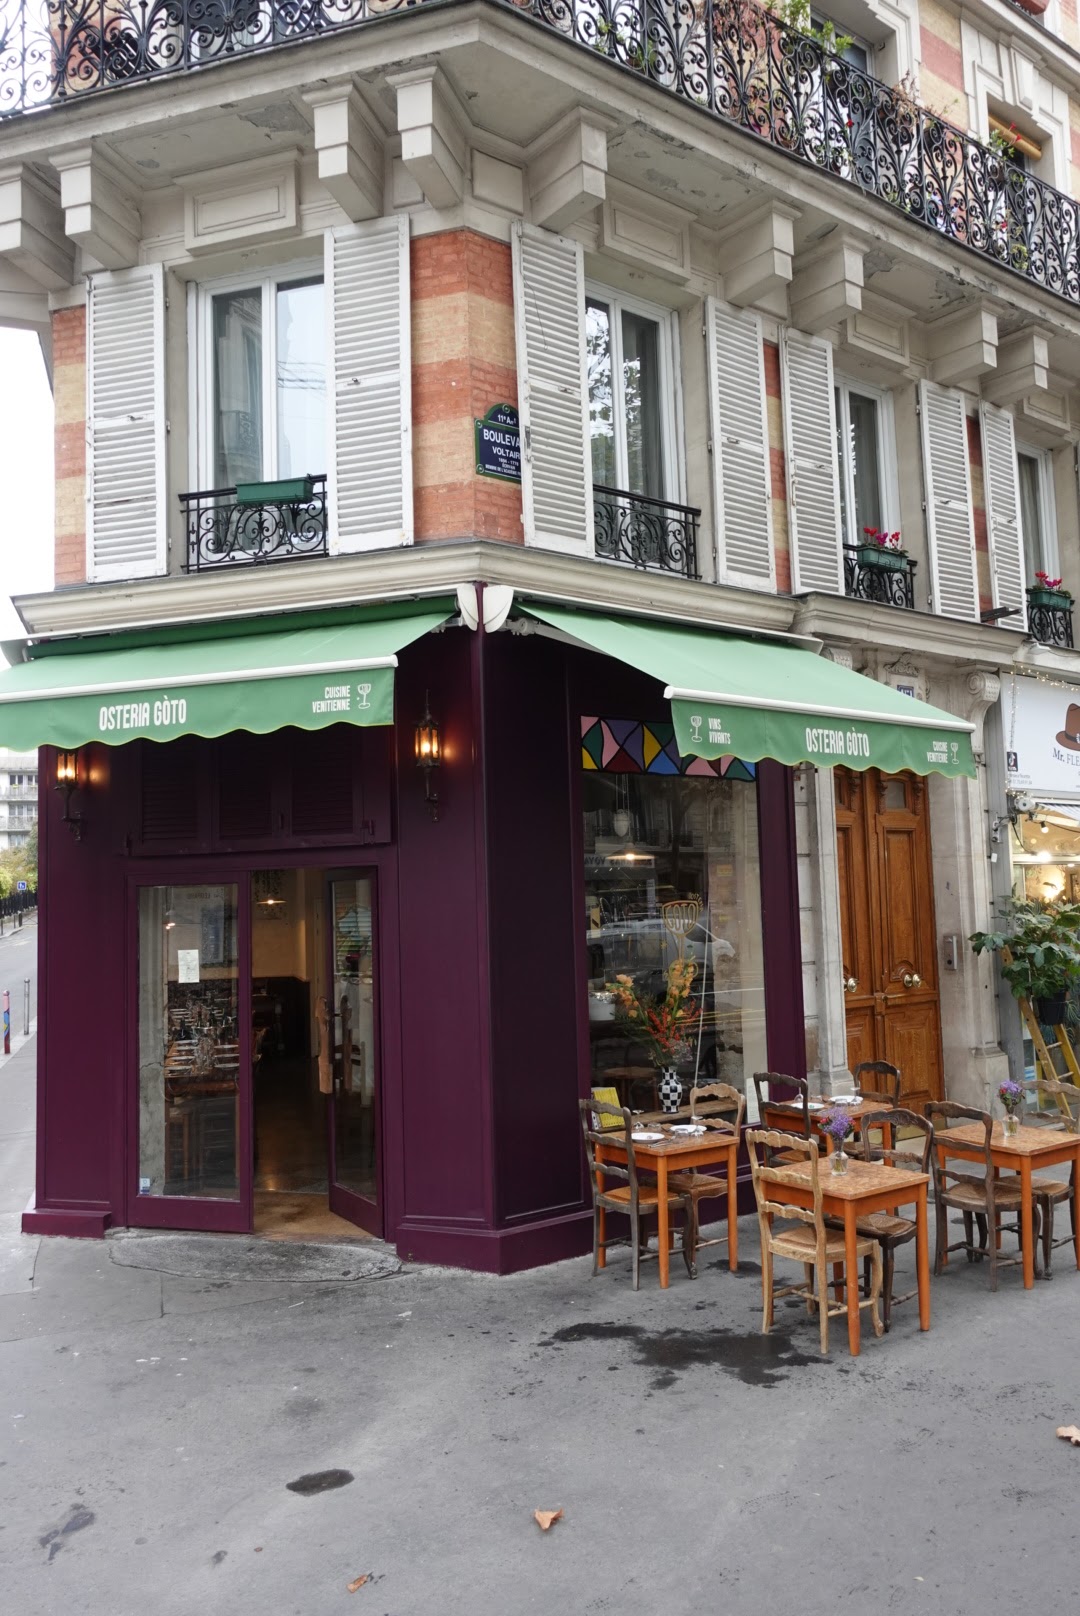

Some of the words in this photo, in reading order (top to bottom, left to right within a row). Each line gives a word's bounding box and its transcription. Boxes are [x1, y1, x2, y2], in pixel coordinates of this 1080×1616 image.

[492, 446, 520, 459] VOLTAIR
[324, 685, 351, 698] CUISINE
[312, 698, 351, 713] VENITIENNE
[99, 702, 149, 731] OSTERIA
[153, 695, 187, 726] GÒTO
[708, 717, 721, 730] VINS
[709, 731, 731, 745] VIVANTS
[805, 727, 844, 754] OSTERIA
[846, 727, 870, 757] GÒTO
[1052, 747, 1065, 762] Mr.
